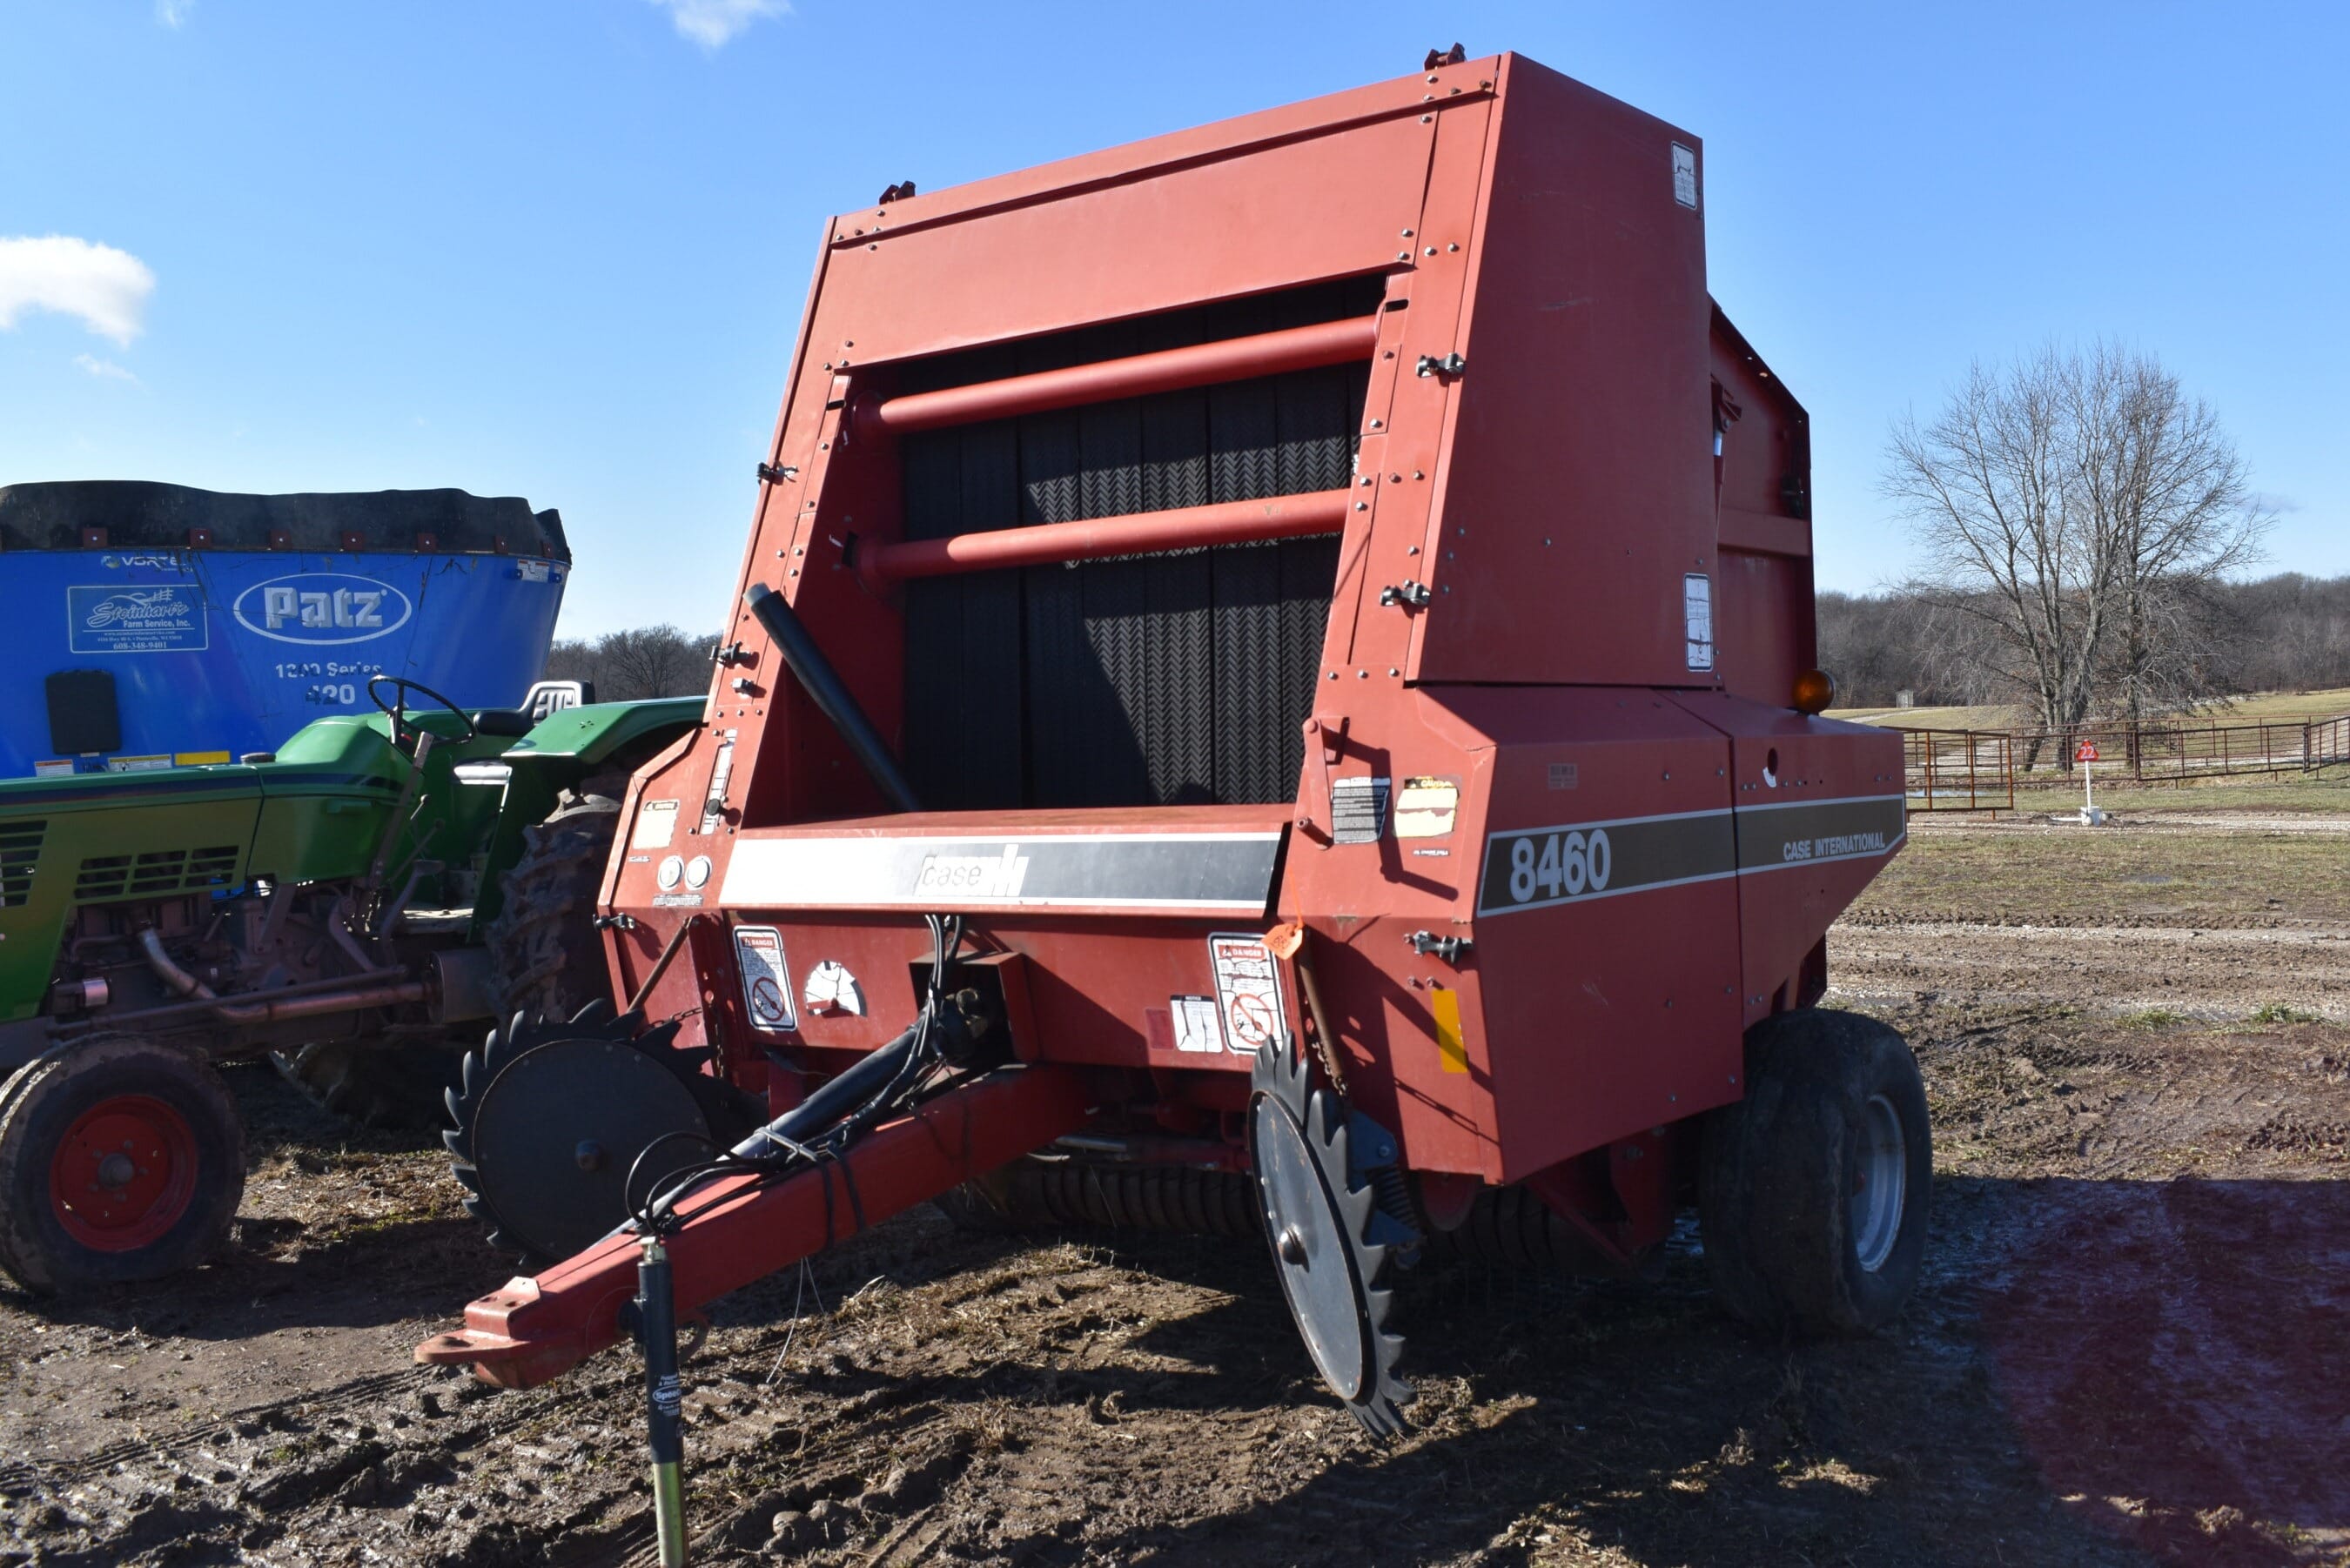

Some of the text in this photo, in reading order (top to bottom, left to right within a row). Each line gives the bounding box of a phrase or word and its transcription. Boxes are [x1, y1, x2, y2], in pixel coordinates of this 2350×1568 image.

[264, 586, 383, 628] Patz
[123, 619, 191, 628] Farm Service, Inc.
[326, 661, 381, 677] Series
[306, 684, 356, 706] 420
[2080, 746, 2094, 759] 22
[1783, 832, 1886, 861] CASE INTERNATIONAL
[1509, 828, 1611, 902] 8460
